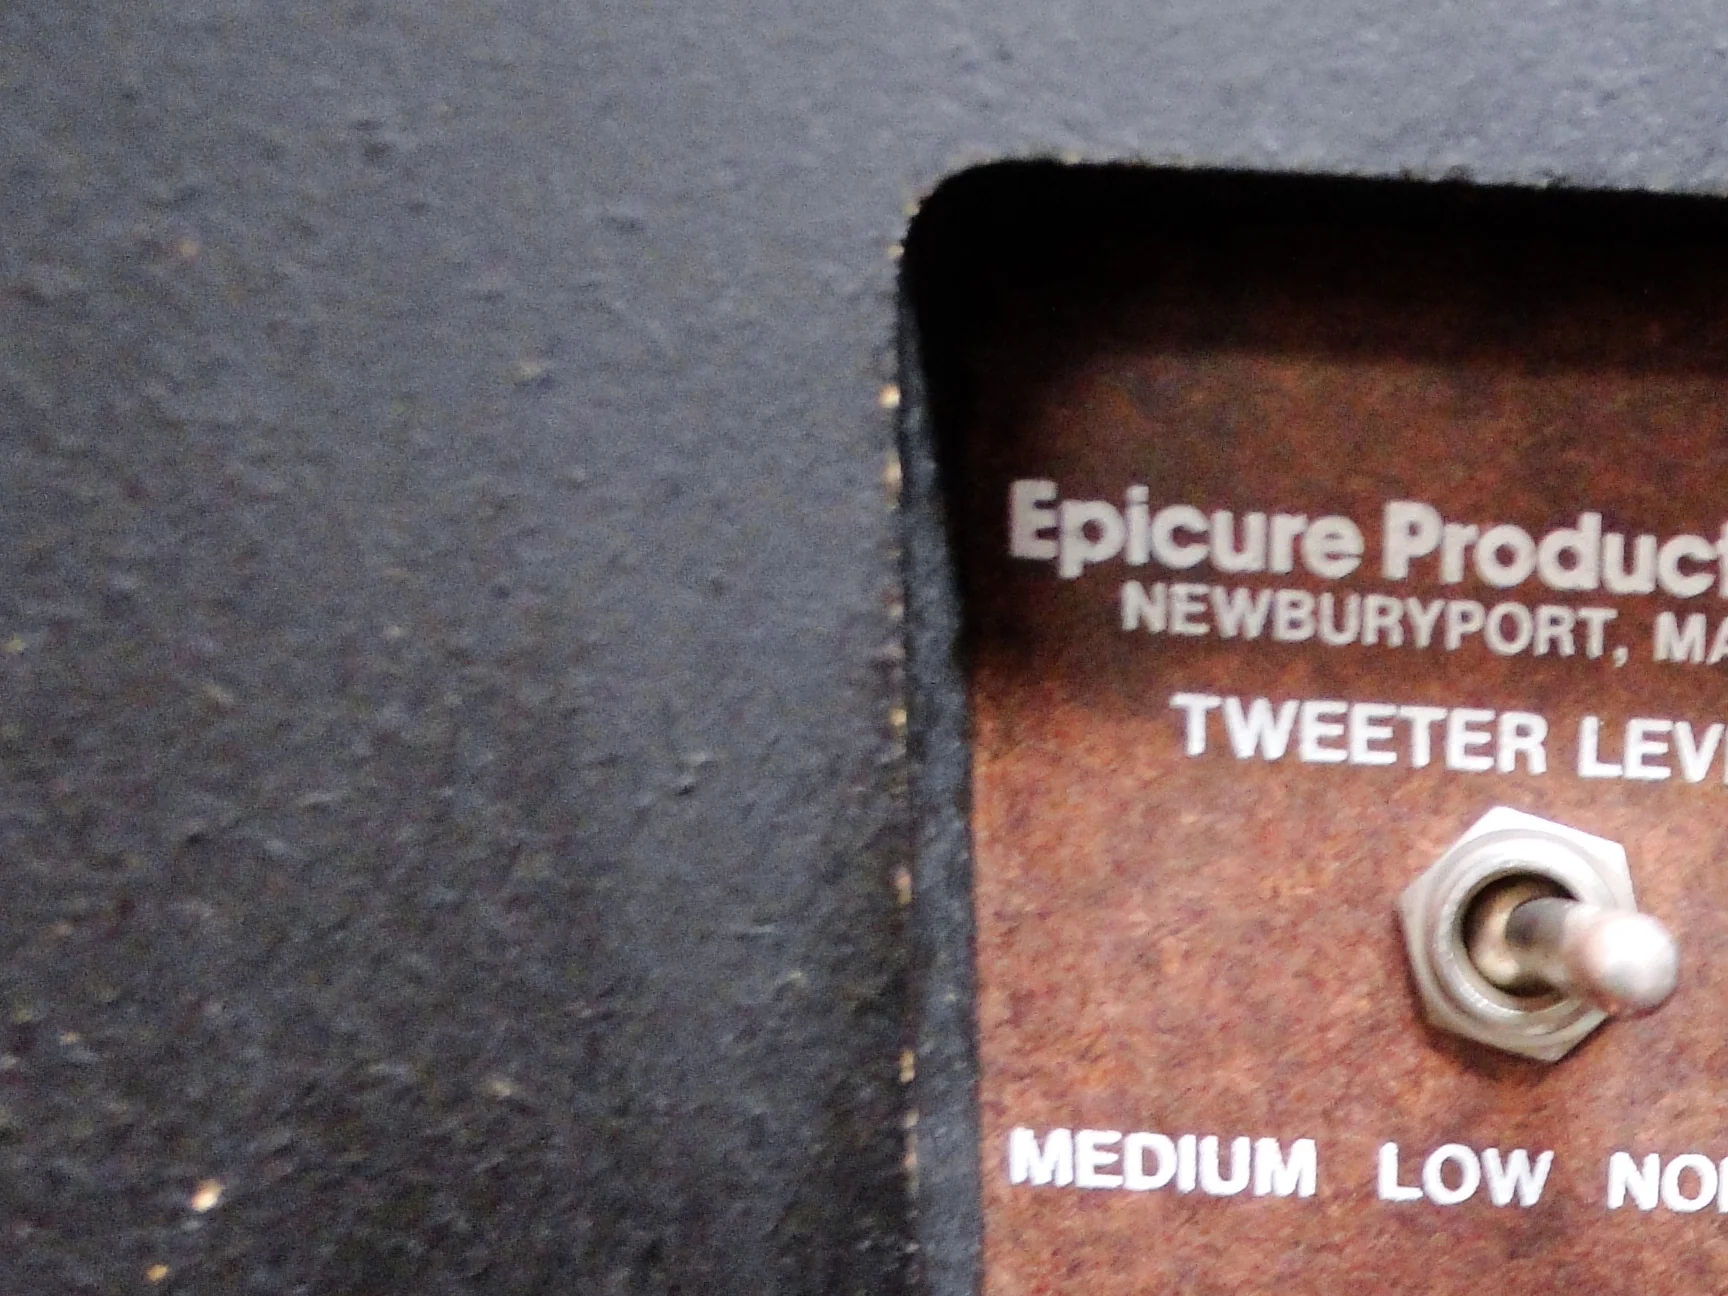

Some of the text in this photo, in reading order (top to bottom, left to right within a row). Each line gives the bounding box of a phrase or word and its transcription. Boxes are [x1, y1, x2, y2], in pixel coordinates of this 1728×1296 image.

[1008, 479, 1364, 579] Epicure
[1120, 580, 1631, 669] NEWBURYPORT,
[1169, 692, 1548, 776] TWEETER
[1008, 1126, 1318, 1198] MEDIUM
[1376, 1142, 1555, 1206] LOW
